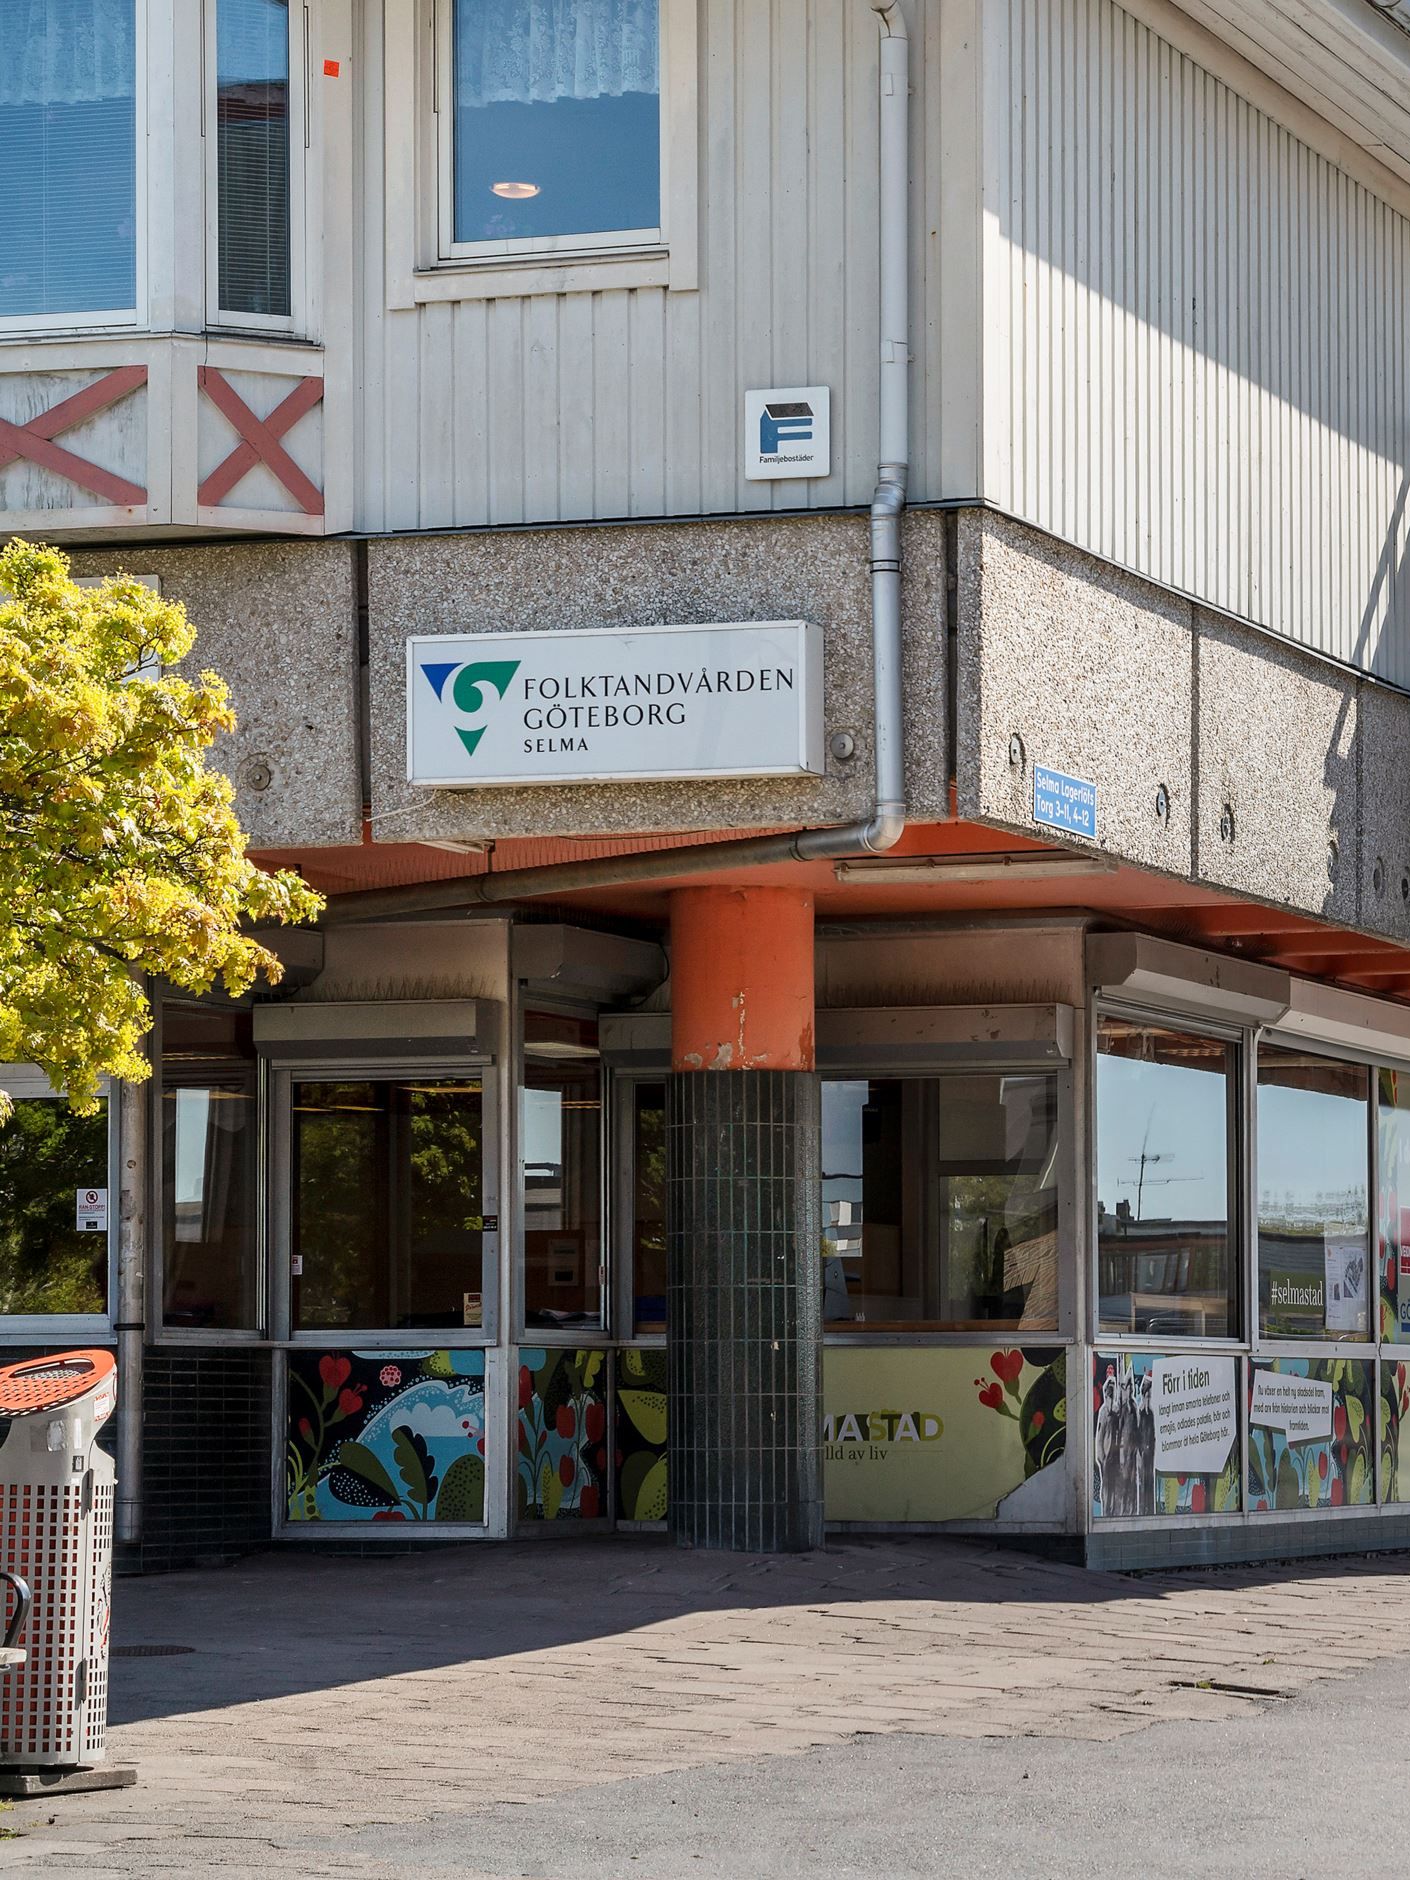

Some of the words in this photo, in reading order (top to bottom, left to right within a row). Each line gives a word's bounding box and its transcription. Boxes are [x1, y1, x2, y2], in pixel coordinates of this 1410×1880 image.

[759, 454, 814, 465] Familjebostäder
[524, 668, 794, 700] FOLKTANDVÅRDEN
[524, 703, 686, 731] GÖTEBORG
[524, 737, 589, 753] SELMA
[1036, 772, 1060, 795] Selma
[1061, 780, 1095, 806] Lagerlöfs
[1036, 794, 1054, 819] Torg
[1073, 807, 1090, 827] 4-12
[1271, 1278, 1324, 1306] #selmastad
[1162, 1373, 1181, 1395] Förr
[1182, 1370, 1186, 1391] i
[1187, 1367, 1210, 1390] tiden
[824, 1409, 945, 1442] ASTAD
[825, 1446, 844, 1460] lld
[848, 1450, 865, 1461] av
[869, 1445, 888, 1460] liv
